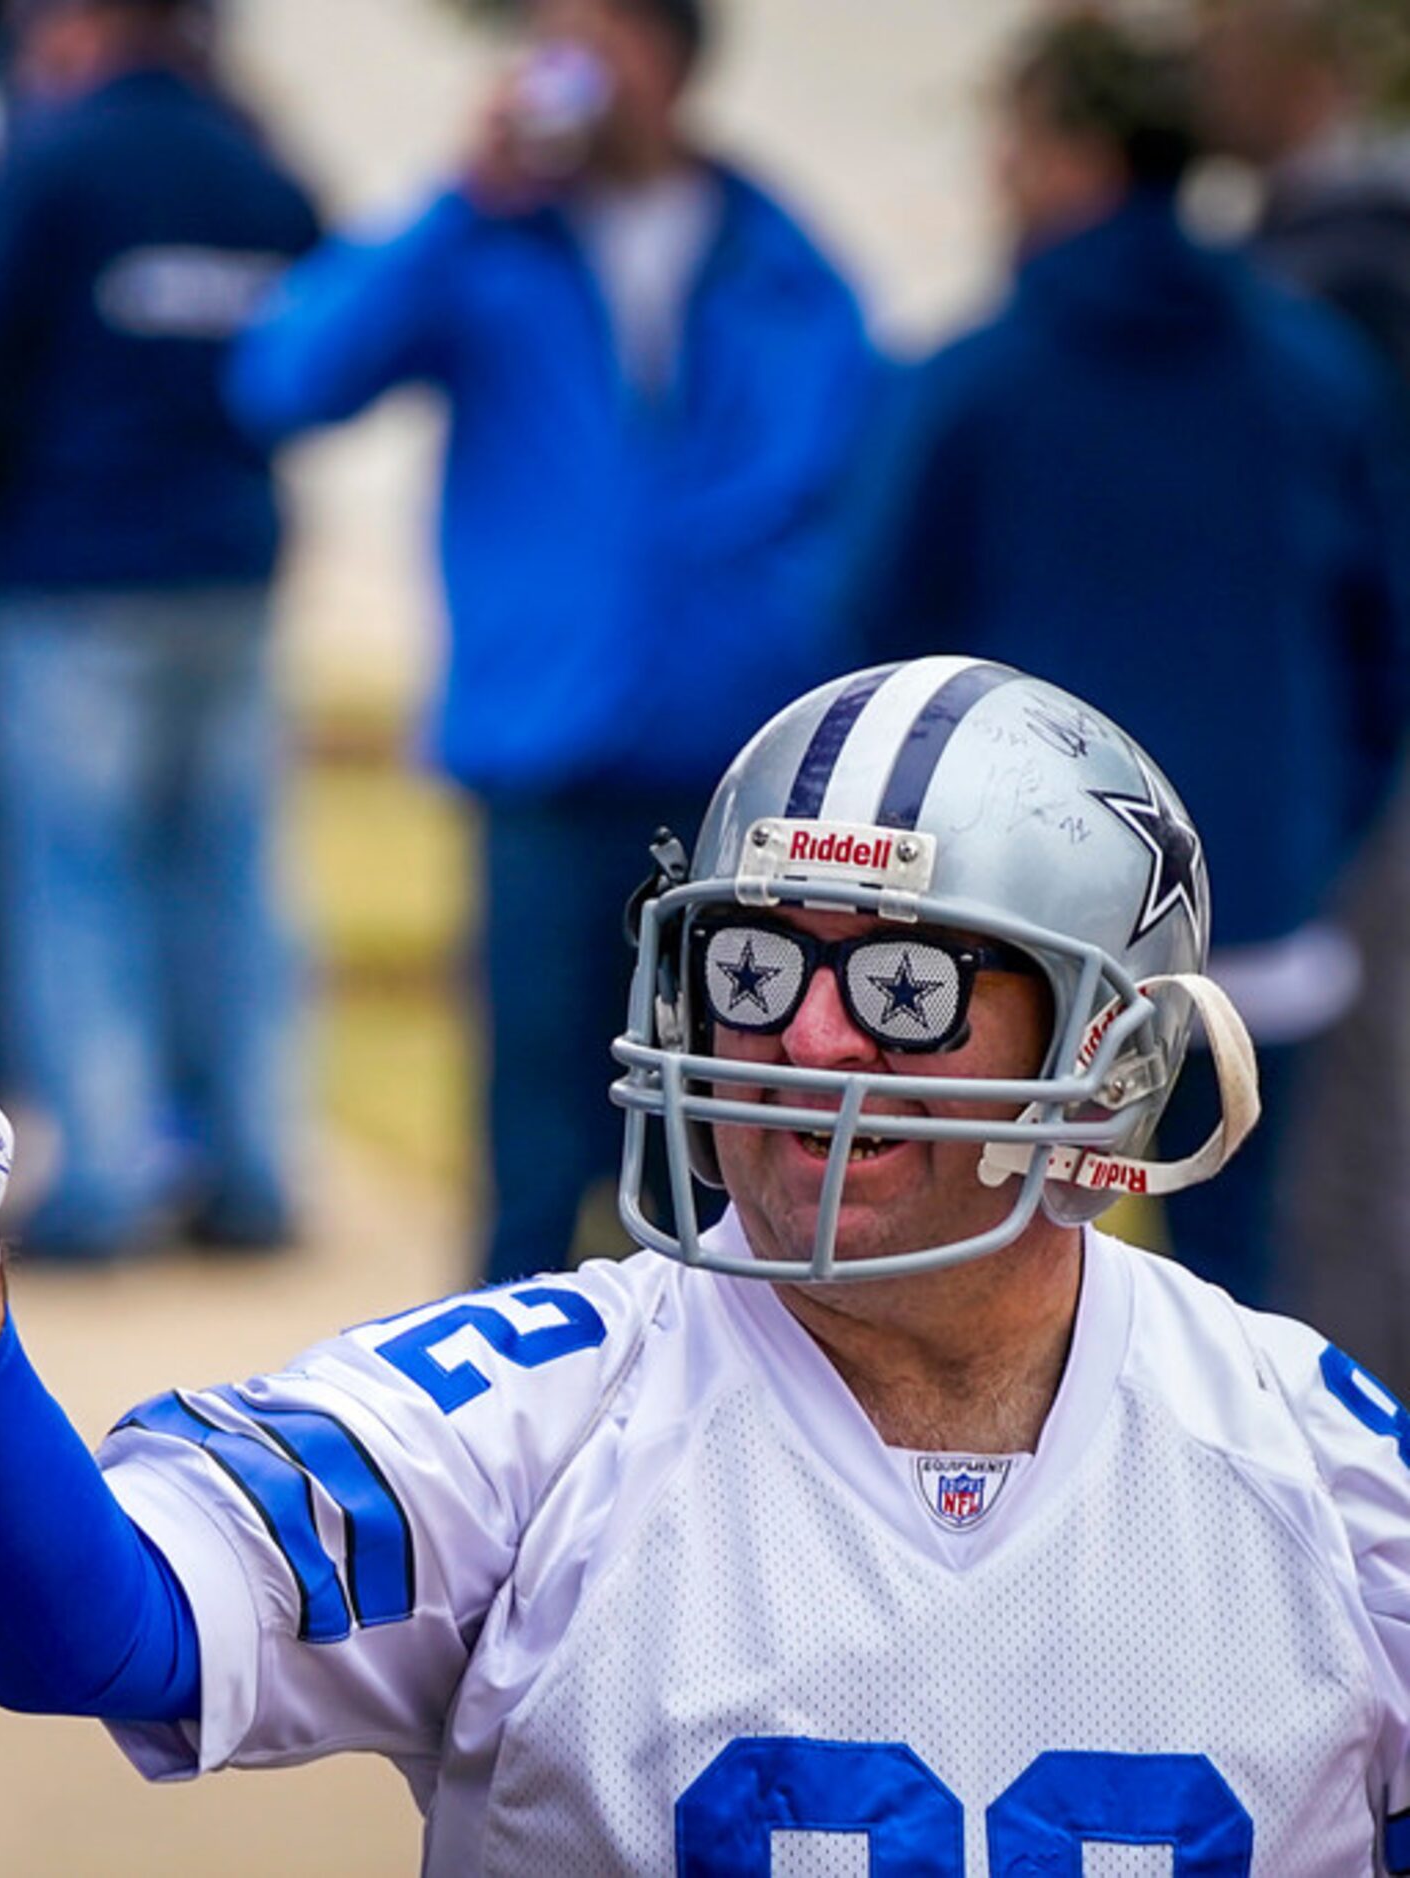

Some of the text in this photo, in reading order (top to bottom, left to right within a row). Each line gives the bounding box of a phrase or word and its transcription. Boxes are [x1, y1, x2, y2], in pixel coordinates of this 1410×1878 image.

[790, 831, 892, 870] Riddell
[340, 1270, 608, 1416] 2
[944, 1491, 982, 1517] NFL
